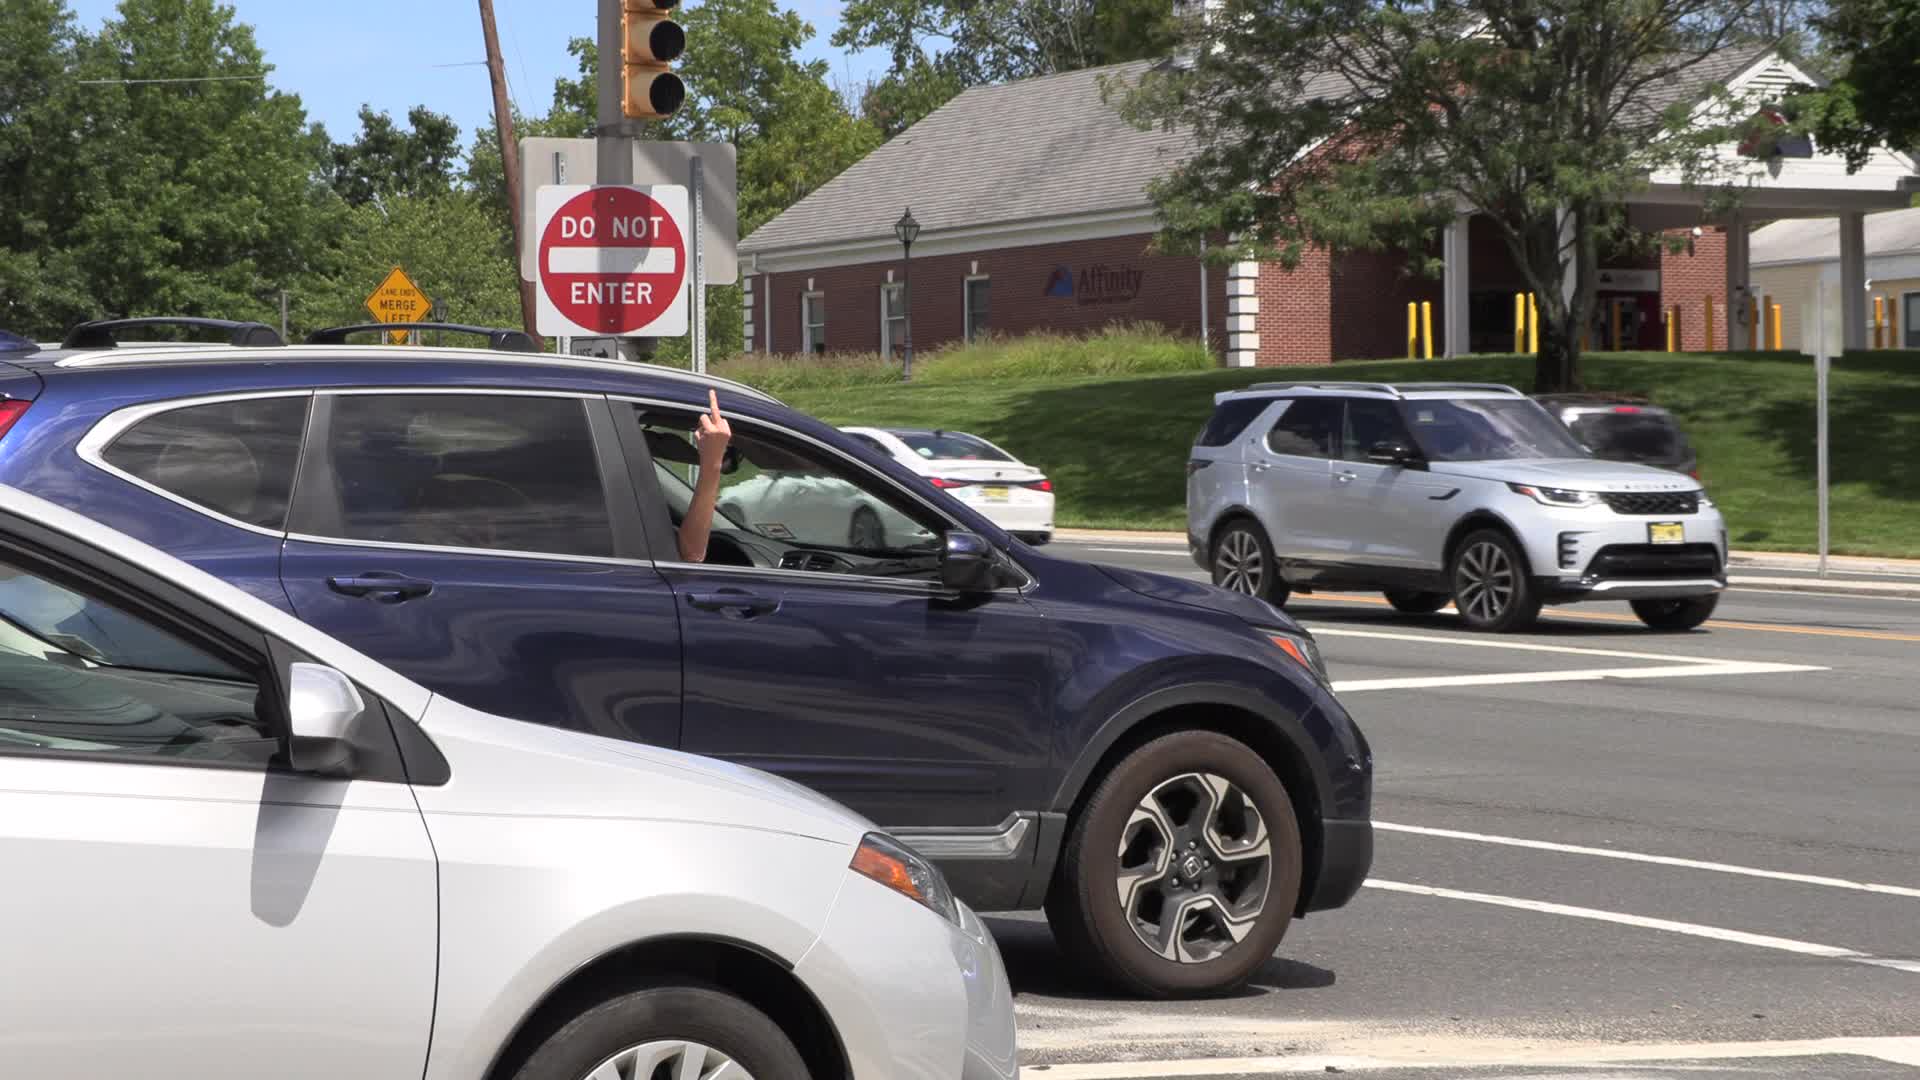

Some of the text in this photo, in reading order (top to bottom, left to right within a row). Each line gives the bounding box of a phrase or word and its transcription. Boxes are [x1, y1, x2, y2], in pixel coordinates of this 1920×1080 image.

[561, 216, 664, 239] DO NOT
[1080, 264, 1143, 299] Affinity
[571, 282, 652, 304] ENTER
[380, 300, 417, 311] MERGE
[385, 312, 411, 323] LEFT
